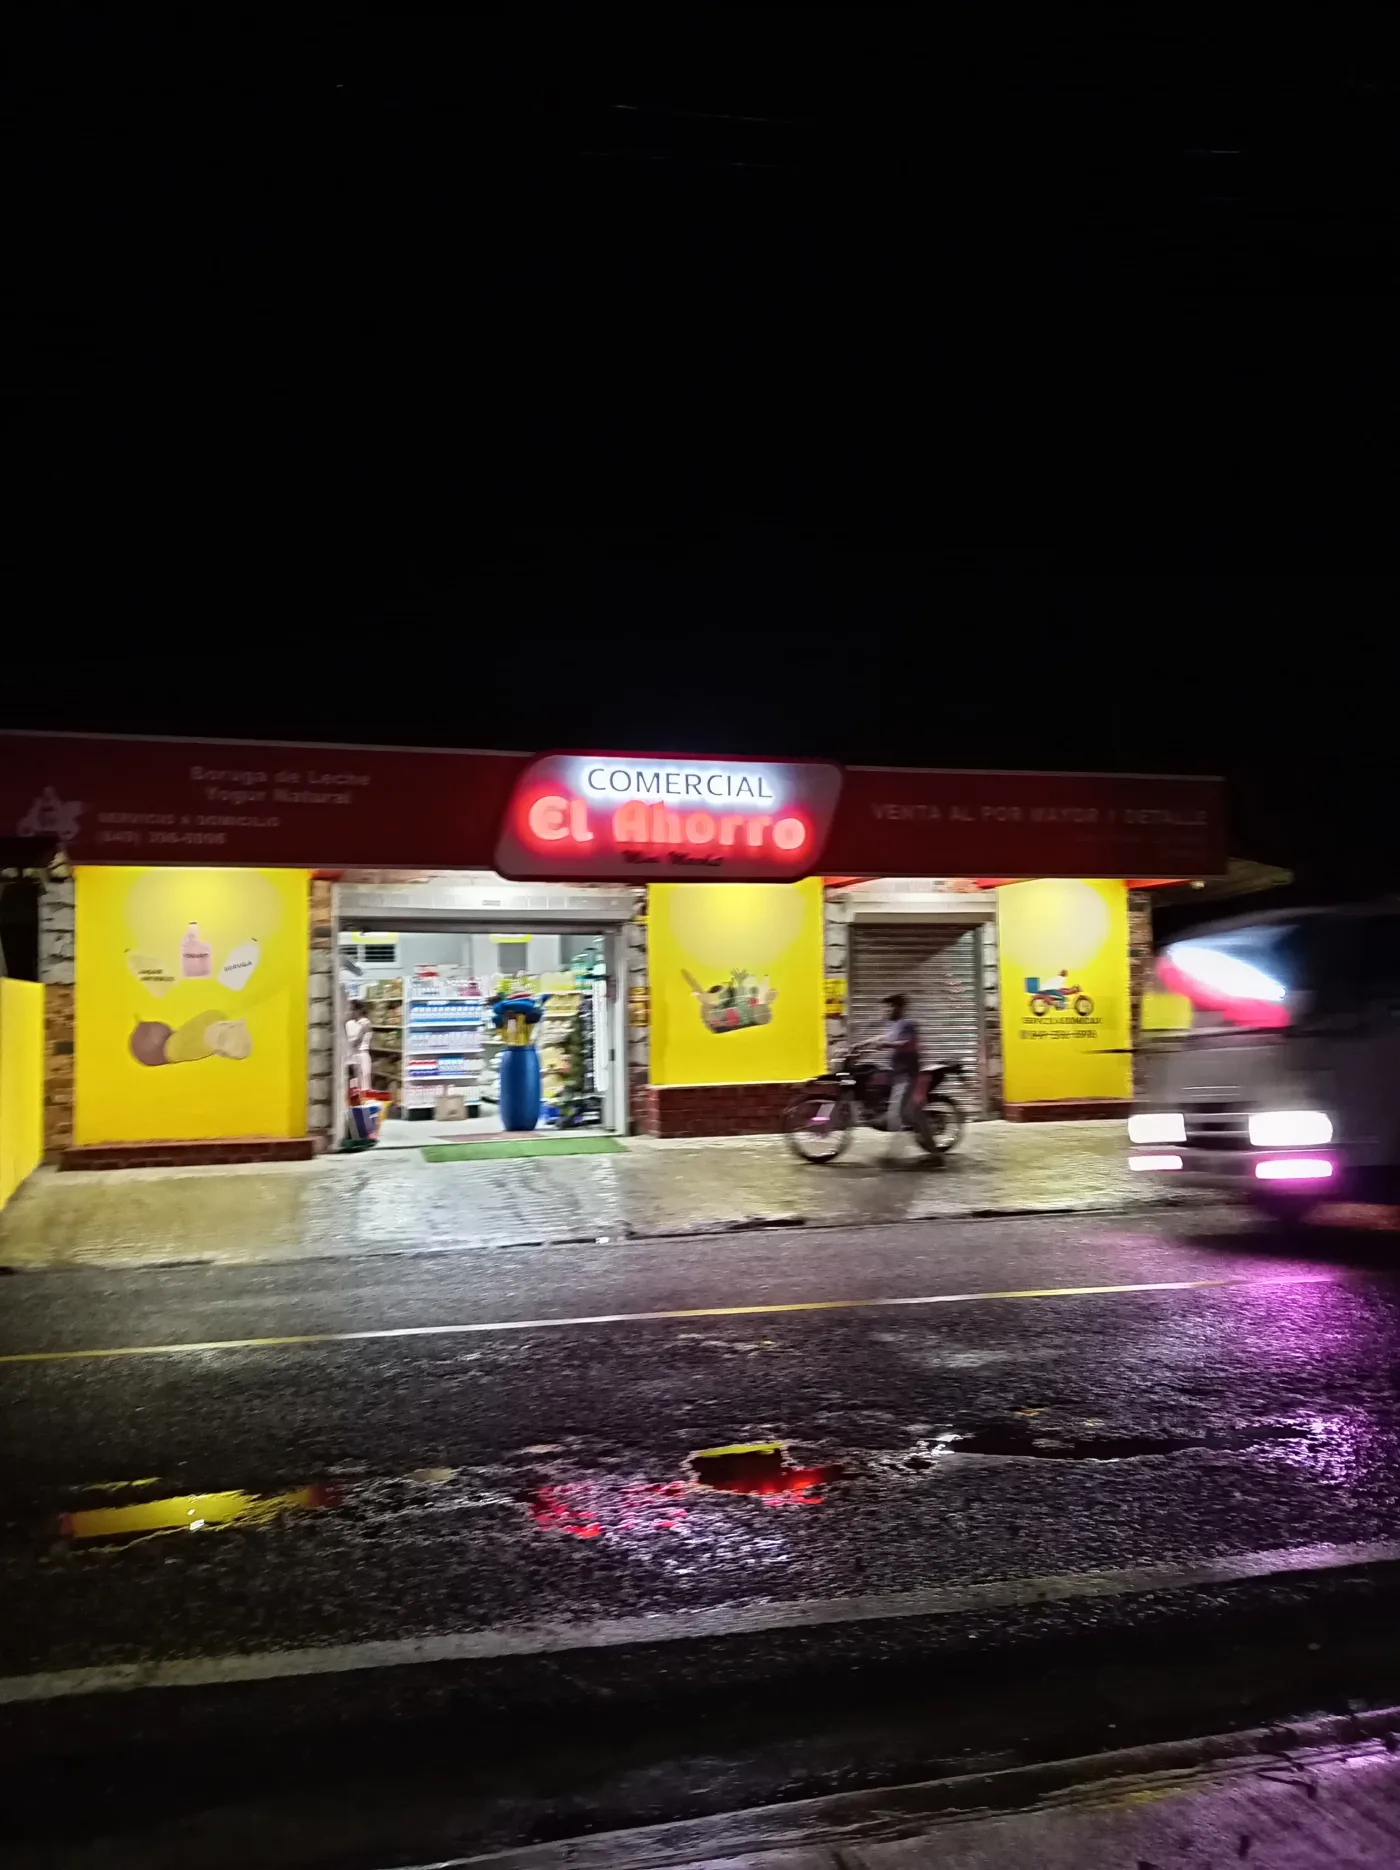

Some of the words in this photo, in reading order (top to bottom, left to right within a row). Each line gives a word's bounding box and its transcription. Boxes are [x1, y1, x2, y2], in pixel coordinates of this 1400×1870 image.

[274, 769, 300, 784] de
[587, 767, 773, 798] COMERCIAL
[613, 799, 807, 850] Ahorro
[870, 804, 943, 821] VENTA
[948, 805, 976, 822] AL
[981, 806, 1022, 822] POR
[1124, 809, 1208, 826] DETALLE
